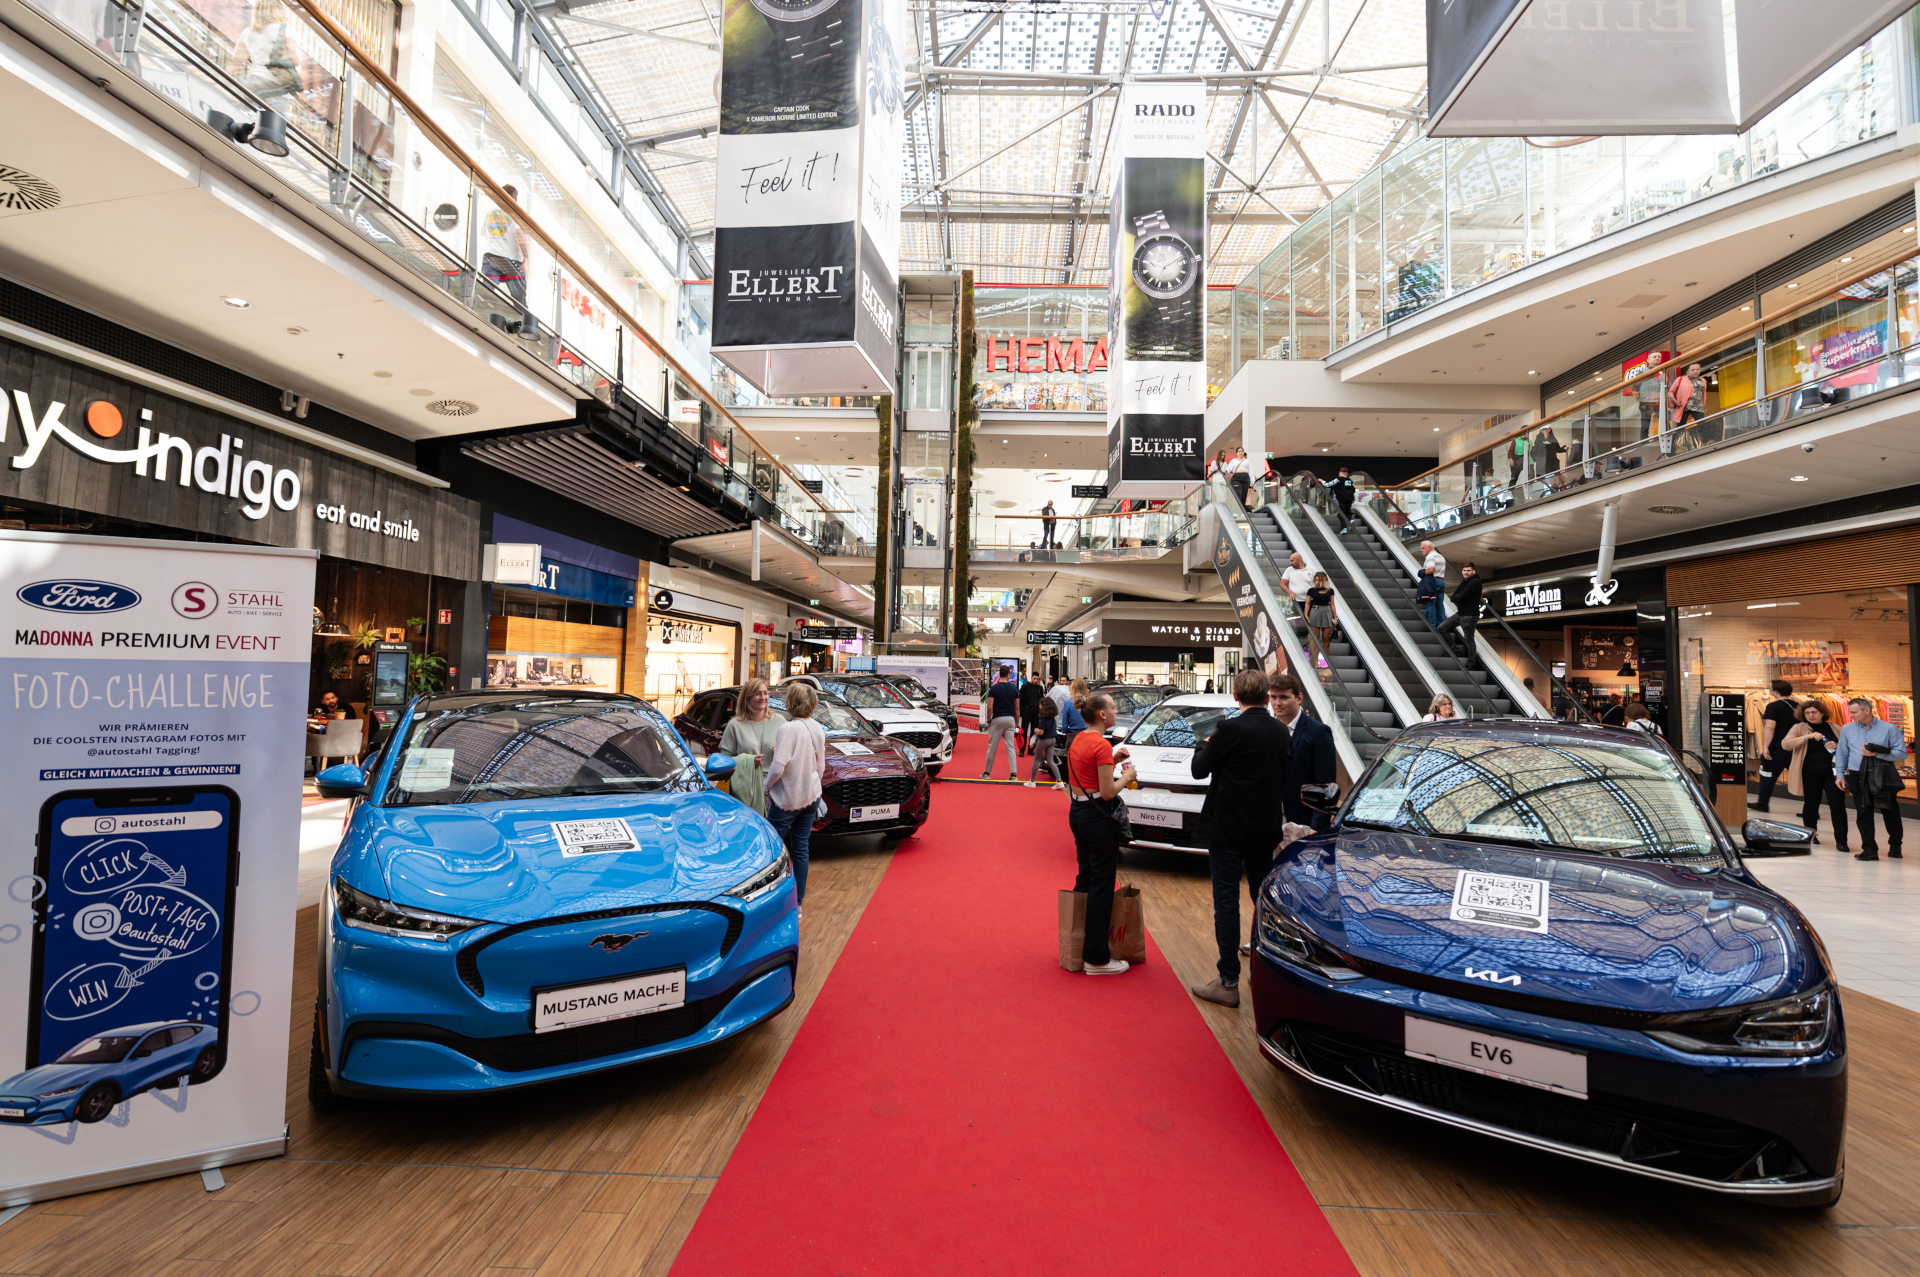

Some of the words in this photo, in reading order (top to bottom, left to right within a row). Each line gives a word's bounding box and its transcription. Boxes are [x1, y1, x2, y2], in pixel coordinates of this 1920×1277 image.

[1134, 104, 1195, 116] RADO
[740, 157, 793, 204] Feel
[802, 151, 830, 191] it
[728, 266, 843, 296] ELLERT
[759, 268, 811, 277] JUWELIERE
[561, 278, 606, 330] BOSCH
[1857, 330, 1876, 343] deine
[987, 337, 1108, 373] HEMA
[1821, 336, 1878, 367] Superkraft!
[1135, 375, 1165, 400] Feel
[1171, 373, 1185, 395] it
[1130, 437, 1196, 453] ELLERT
[135, 408, 301, 521] indigo
[1073, 487, 1077, 496] 1
[316, 502, 346, 526] eat
[349, 510, 380, 534] and
[383, 516, 420, 542] smile
[500, 559, 531, 568] ELLERT
[42, 584, 118, 609] Ford
[184, 588, 206, 612] S
[228, 593, 283, 606] STAHL
[15, 630, 93, 646] MADONNA
[101, 632, 210, 649] PREMIUM
[215, 635, 281, 650] EVENT
[802, 628, 807, 637] 0
[1028, 633, 1034, 642] 0
[13, 672, 274, 710] FOTO-CHALLENGE
[1716, 696, 1724, 708] 0
[99, 724, 121, 732] WIR
[124, 722, 189, 732] PRÄMIEREN
[33, 737, 53, 745] DIE
[56, 736, 118, 745] COOLSTEN
[121, 735, 187, 744] INSTAGRAM
[190, 734, 225, 742] FOTOS
[227, 734, 247, 742] MIT
[87, 747, 152, 757] @autostahl
[155, 746, 200, 756] Tagging!
[43, 769, 87, 780] GLEICH
[89, 767, 160, 778] MITMACHEN
[162, 767, 171, 775] &
[174, 765, 236, 776] GEWINNEN!
[121, 816, 186, 828] autostahl
[80, 850, 138, 884] CLICK
[120, 890, 210, 932] POST+TAGG
[118, 922, 195, 950] @autostahl
[69, 980, 109, 1007] WIN
[543, 993, 618, 1015] MUSTANG
[624, 982, 679, 1001] MACH-E
[1470, 1041, 1513, 1065] EV6
